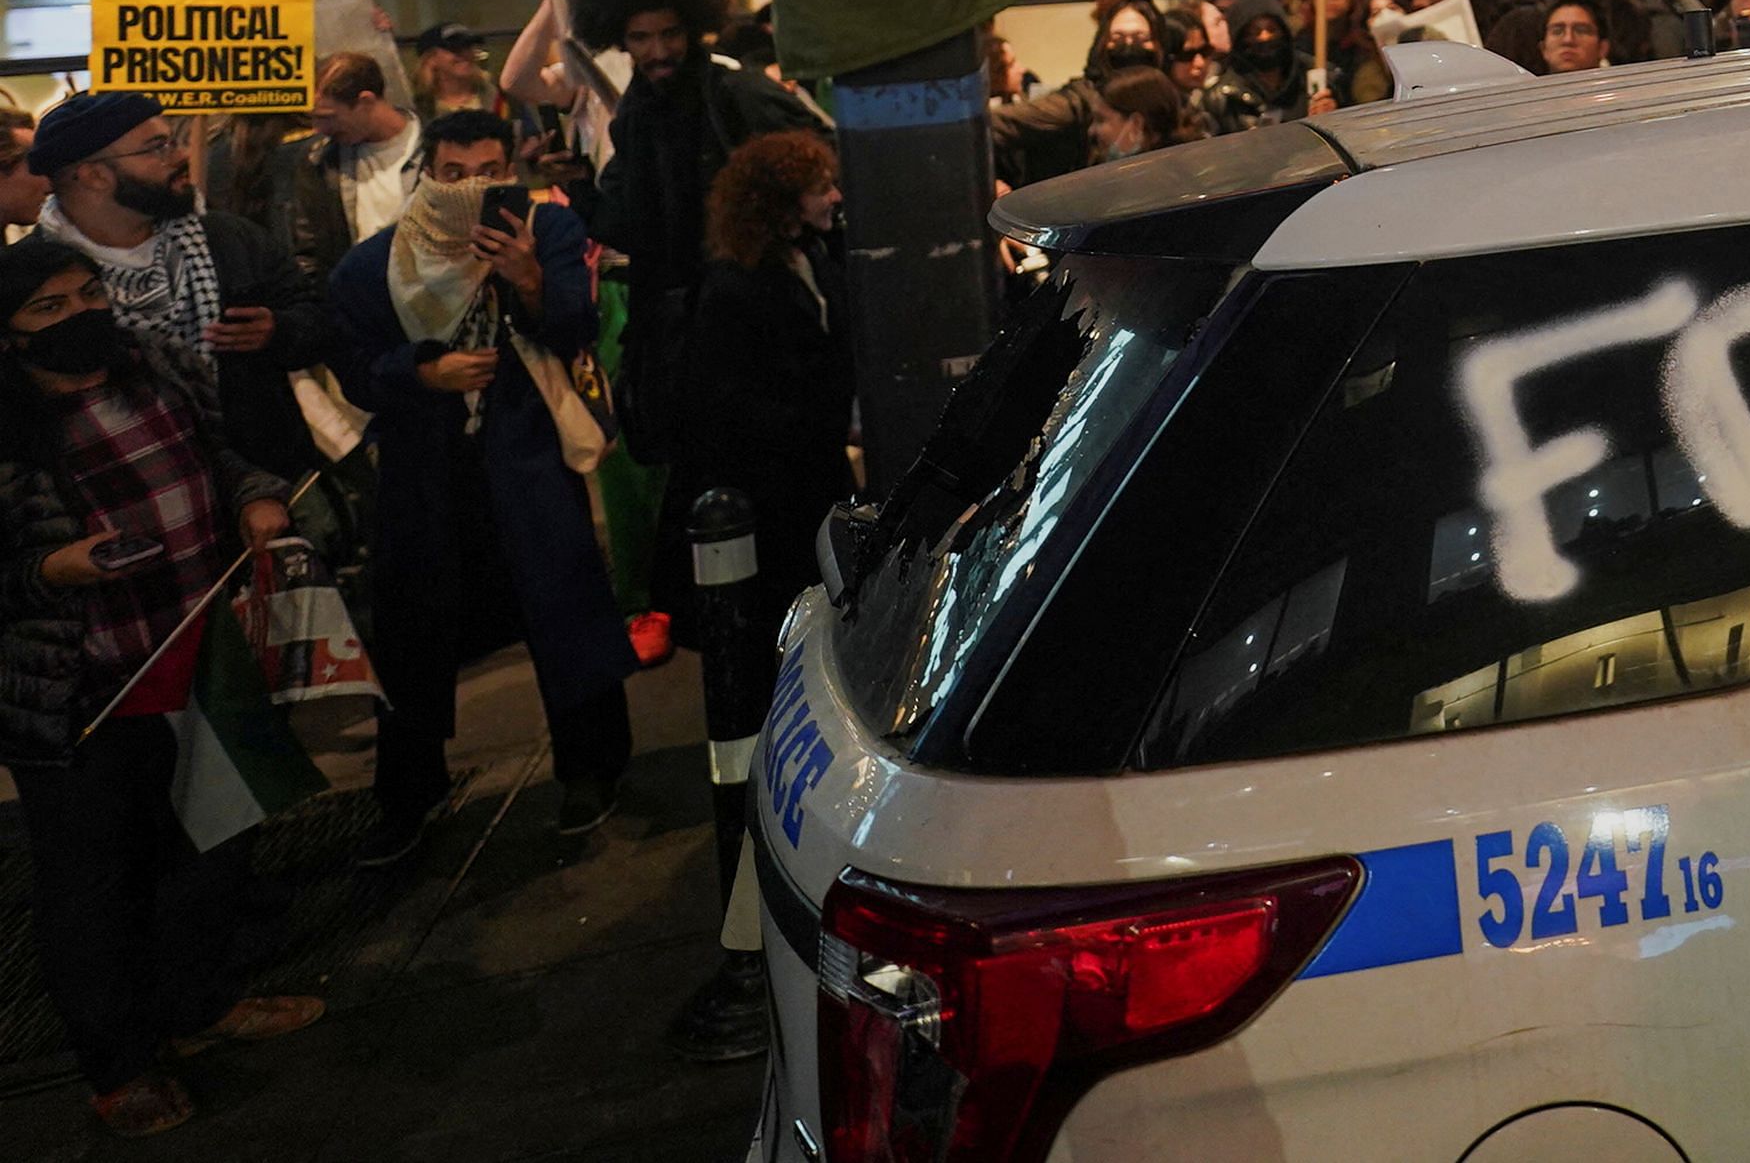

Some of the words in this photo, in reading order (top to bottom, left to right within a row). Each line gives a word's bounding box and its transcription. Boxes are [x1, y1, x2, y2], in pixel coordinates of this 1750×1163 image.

[118, 5, 288, 41] POLITICAL
[103, 45, 304, 84] PRISONERS!
[221, 88, 303, 106] Coalition
[1475, 803, 1671, 948] 5247
[1678, 850, 1724, 913] 16
